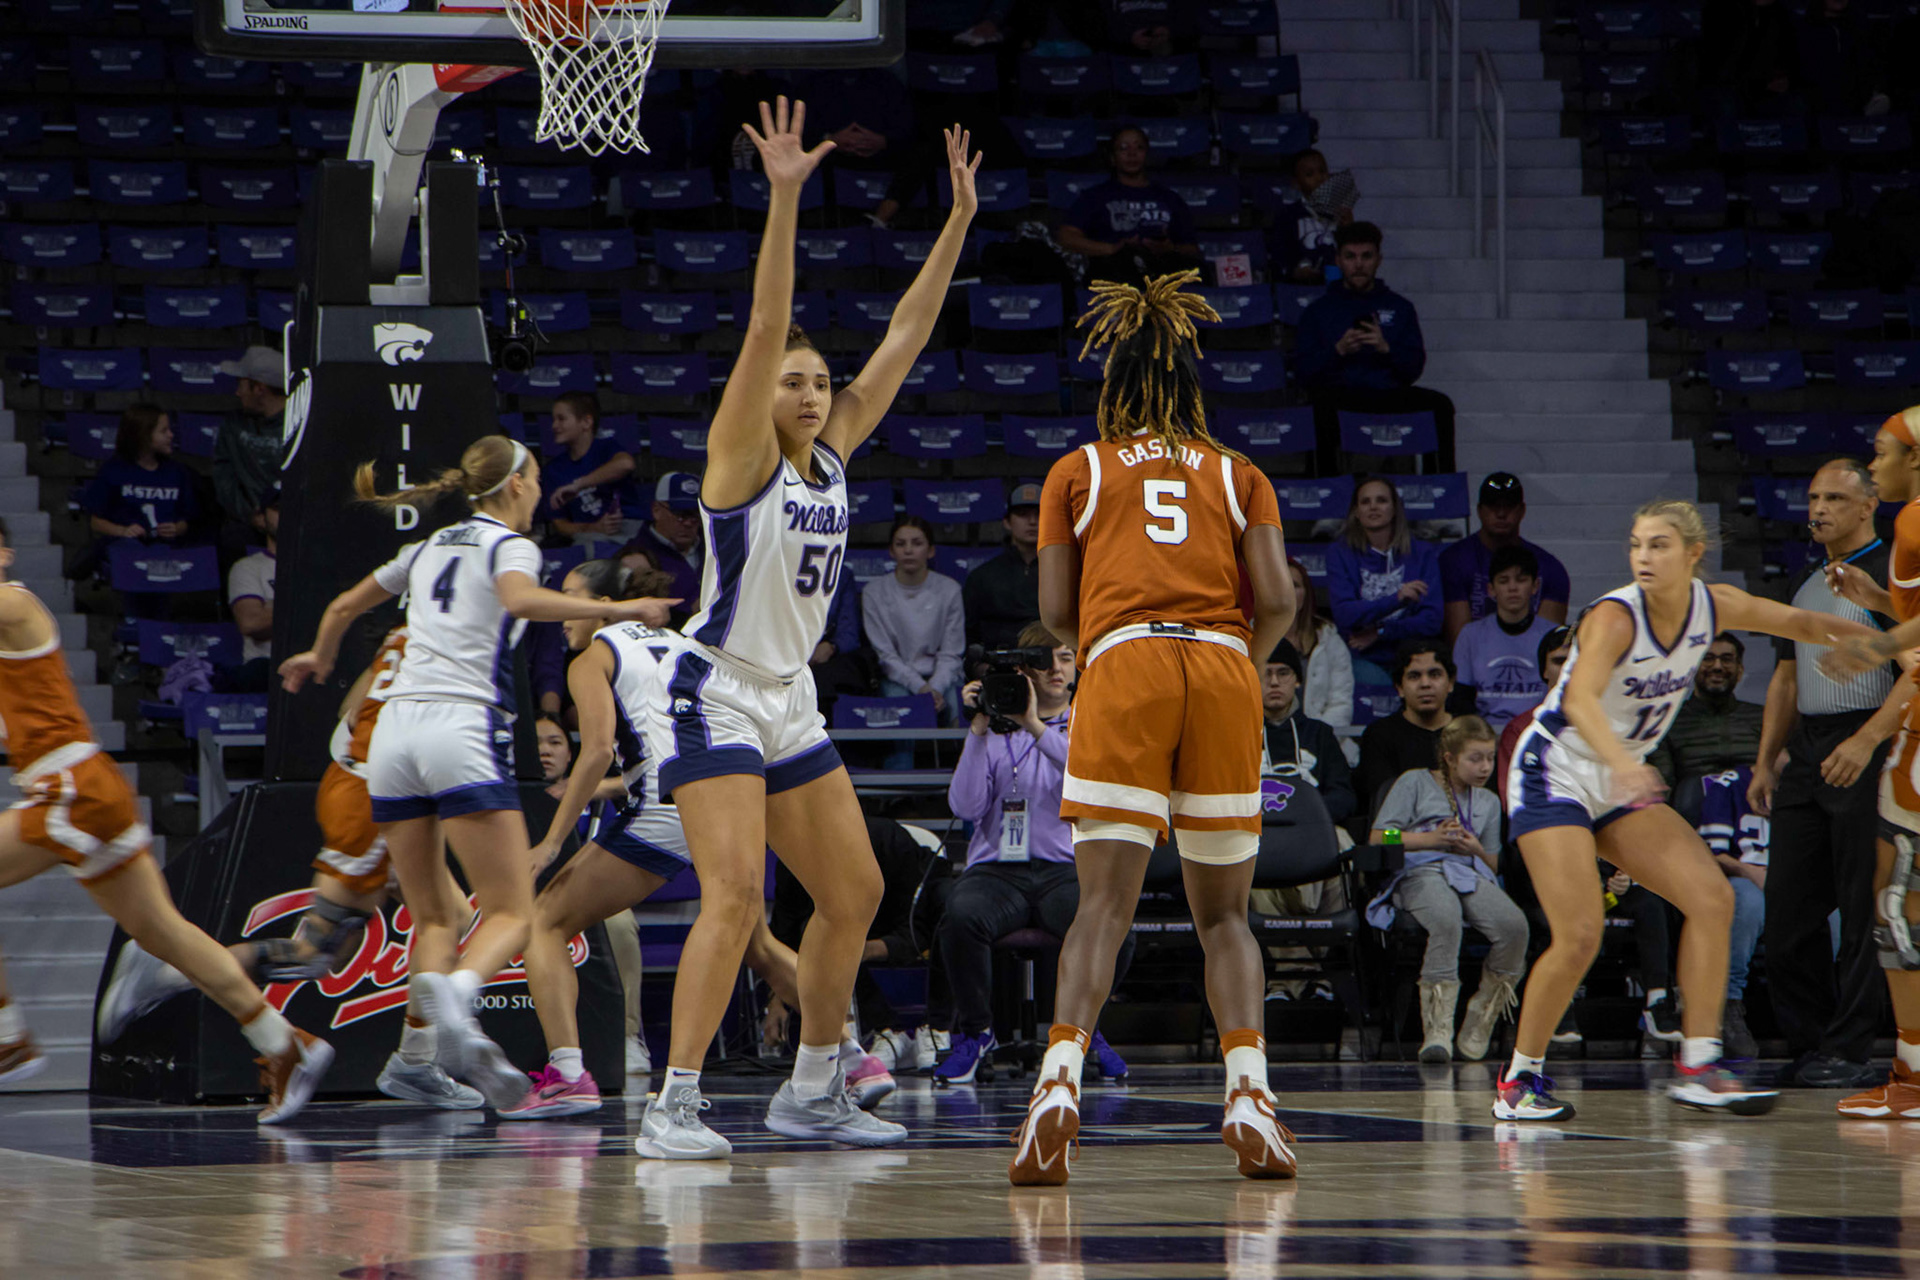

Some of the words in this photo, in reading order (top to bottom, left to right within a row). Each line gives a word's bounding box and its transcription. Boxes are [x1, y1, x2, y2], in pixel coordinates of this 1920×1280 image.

[244, 15, 308, 30] SPALDING
[1143, 479, 1188, 545] 5
[430, 556, 463, 614] 4
[794, 543, 842, 598] 50
[1626, 701, 1671, 741] 12
[1009, 828, 1024, 846] TV
[474, 996, 508, 1009] OOD
[511, 996, 536, 1009] STO
